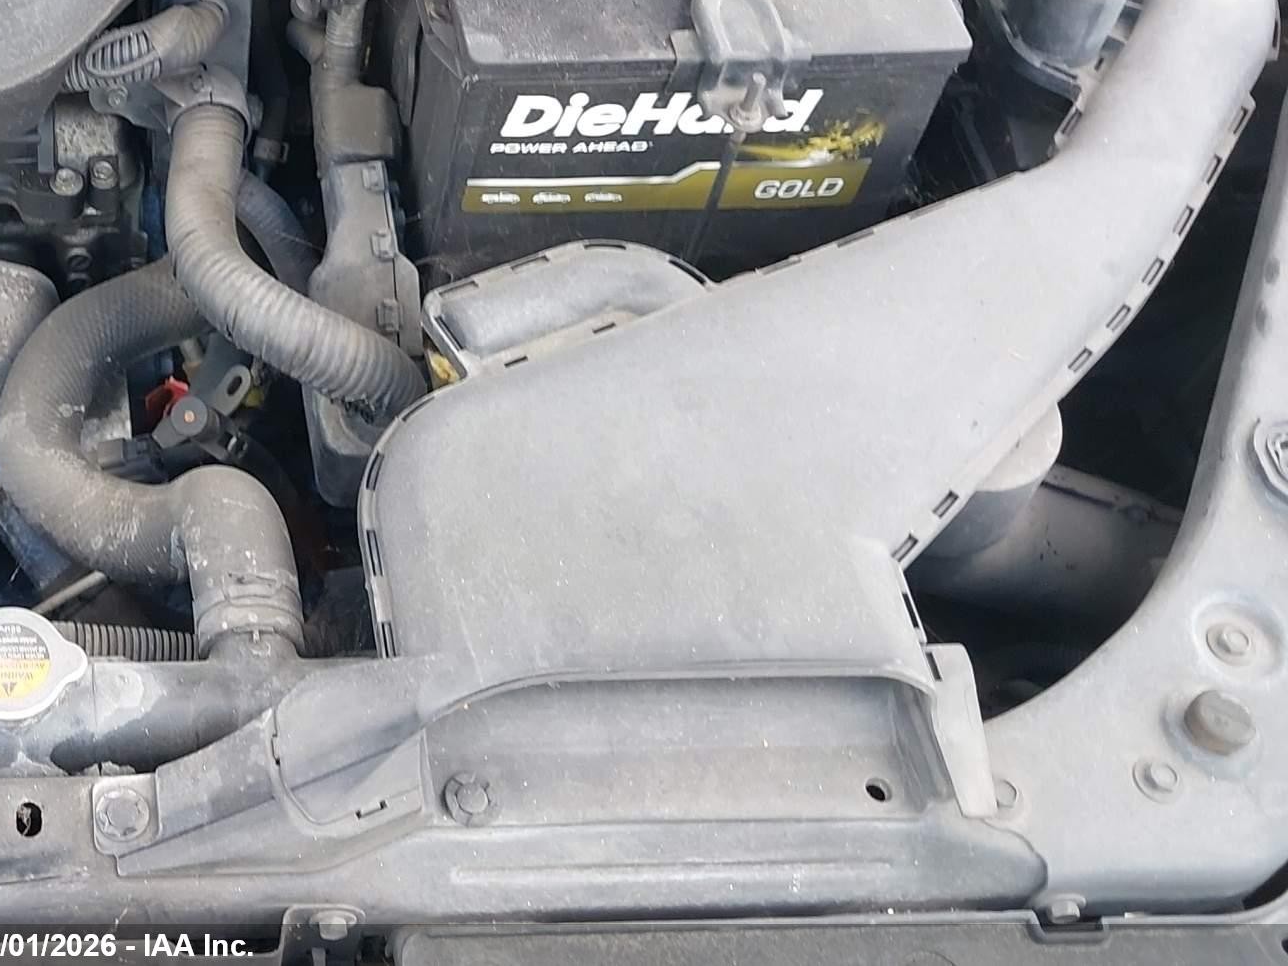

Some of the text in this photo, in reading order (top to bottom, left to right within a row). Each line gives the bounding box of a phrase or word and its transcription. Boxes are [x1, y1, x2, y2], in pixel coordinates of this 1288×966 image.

[500, 89, 824, 138] DieHad
[490, 140, 567, 155] POWER
[753, 177, 845, 200] GOLD
